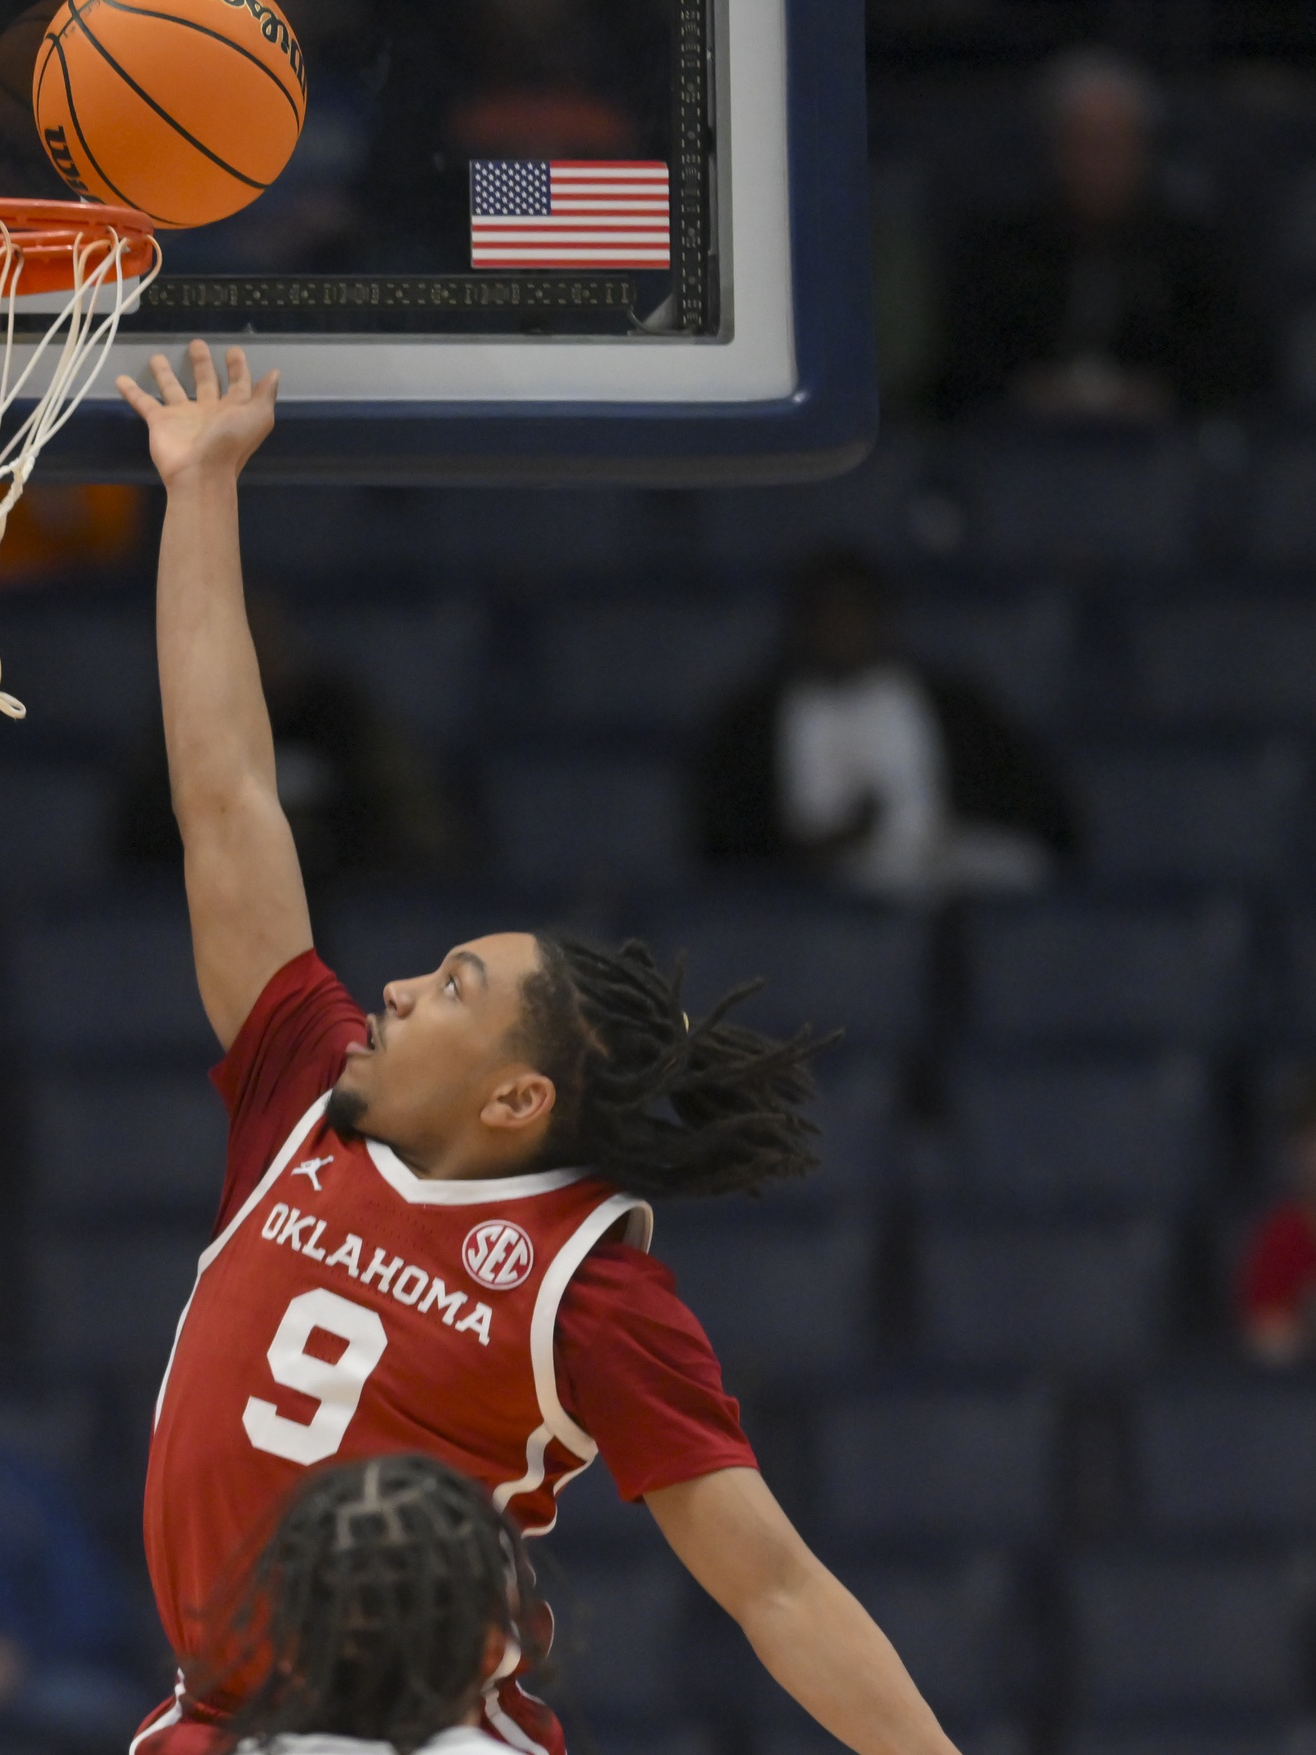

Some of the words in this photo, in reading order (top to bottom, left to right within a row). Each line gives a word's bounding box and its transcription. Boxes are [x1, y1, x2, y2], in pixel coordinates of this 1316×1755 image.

[261, 1202, 493, 1346] OKLAHOMA
[467, 1224, 528, 1284] SEC
[242, 1287, 388, 1466] 9
